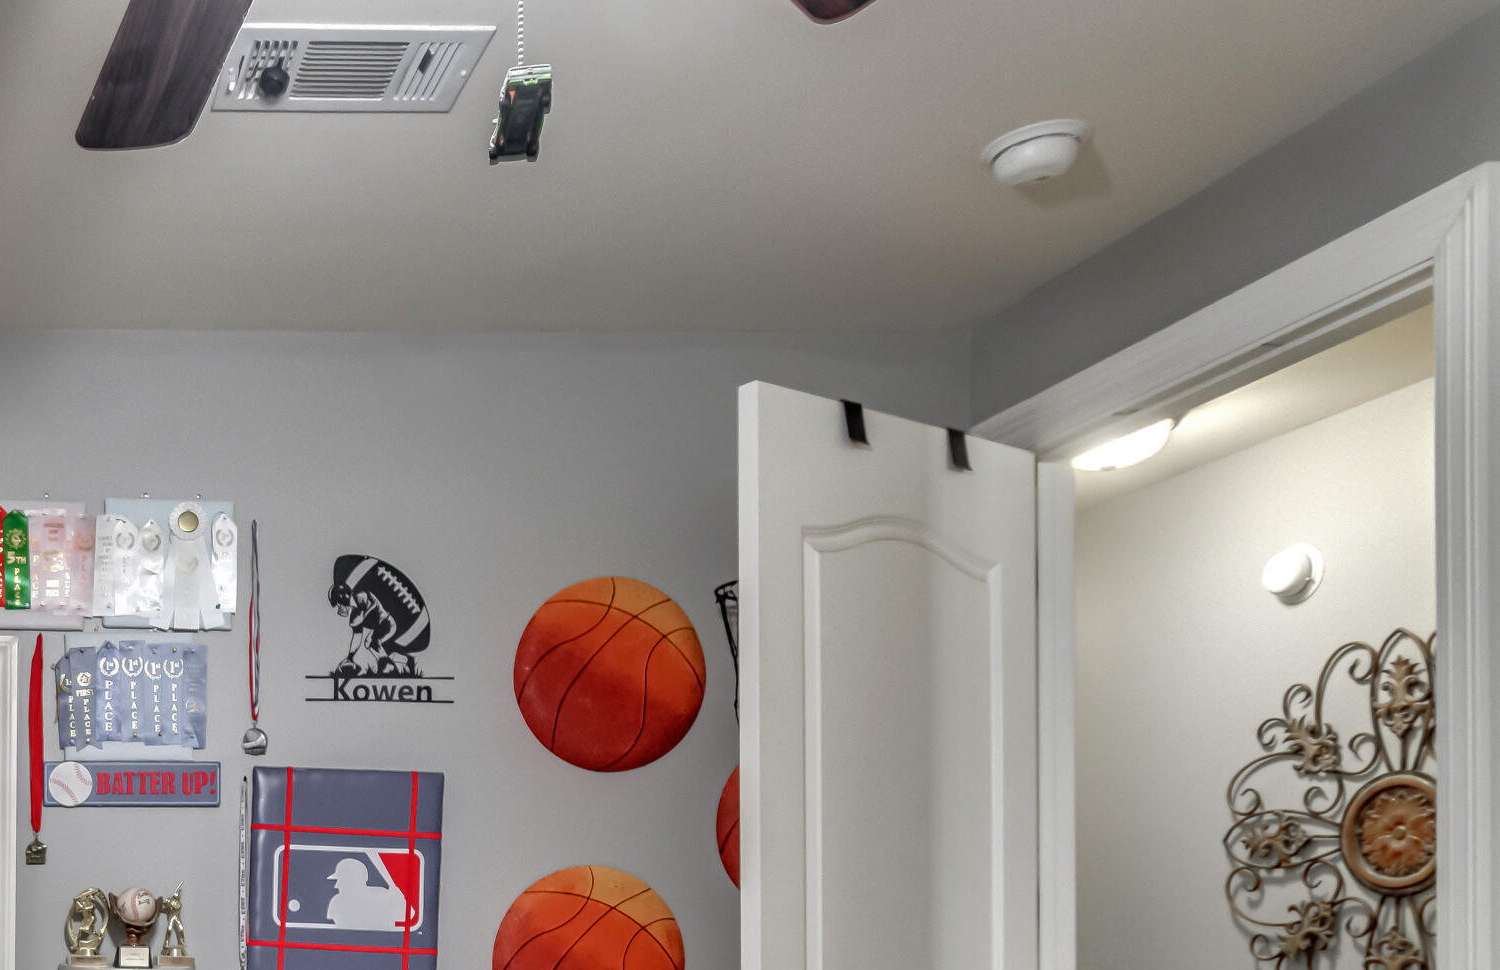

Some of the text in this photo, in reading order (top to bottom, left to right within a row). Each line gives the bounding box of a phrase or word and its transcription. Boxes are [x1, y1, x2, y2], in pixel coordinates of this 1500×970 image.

[7, 551, 26, 564] 5TH
[104, 680, 114, 731] PLACE
[130, 681, 138, 730] PLACE
[153, 685, 161, 732] PLACE
[334, 678, 432, 700] Kowen
[68, 695, 76, 737] PLACE
[83, 698, 92, 735] PLACE
[96, 771, 216, 795] BATTER UP!
